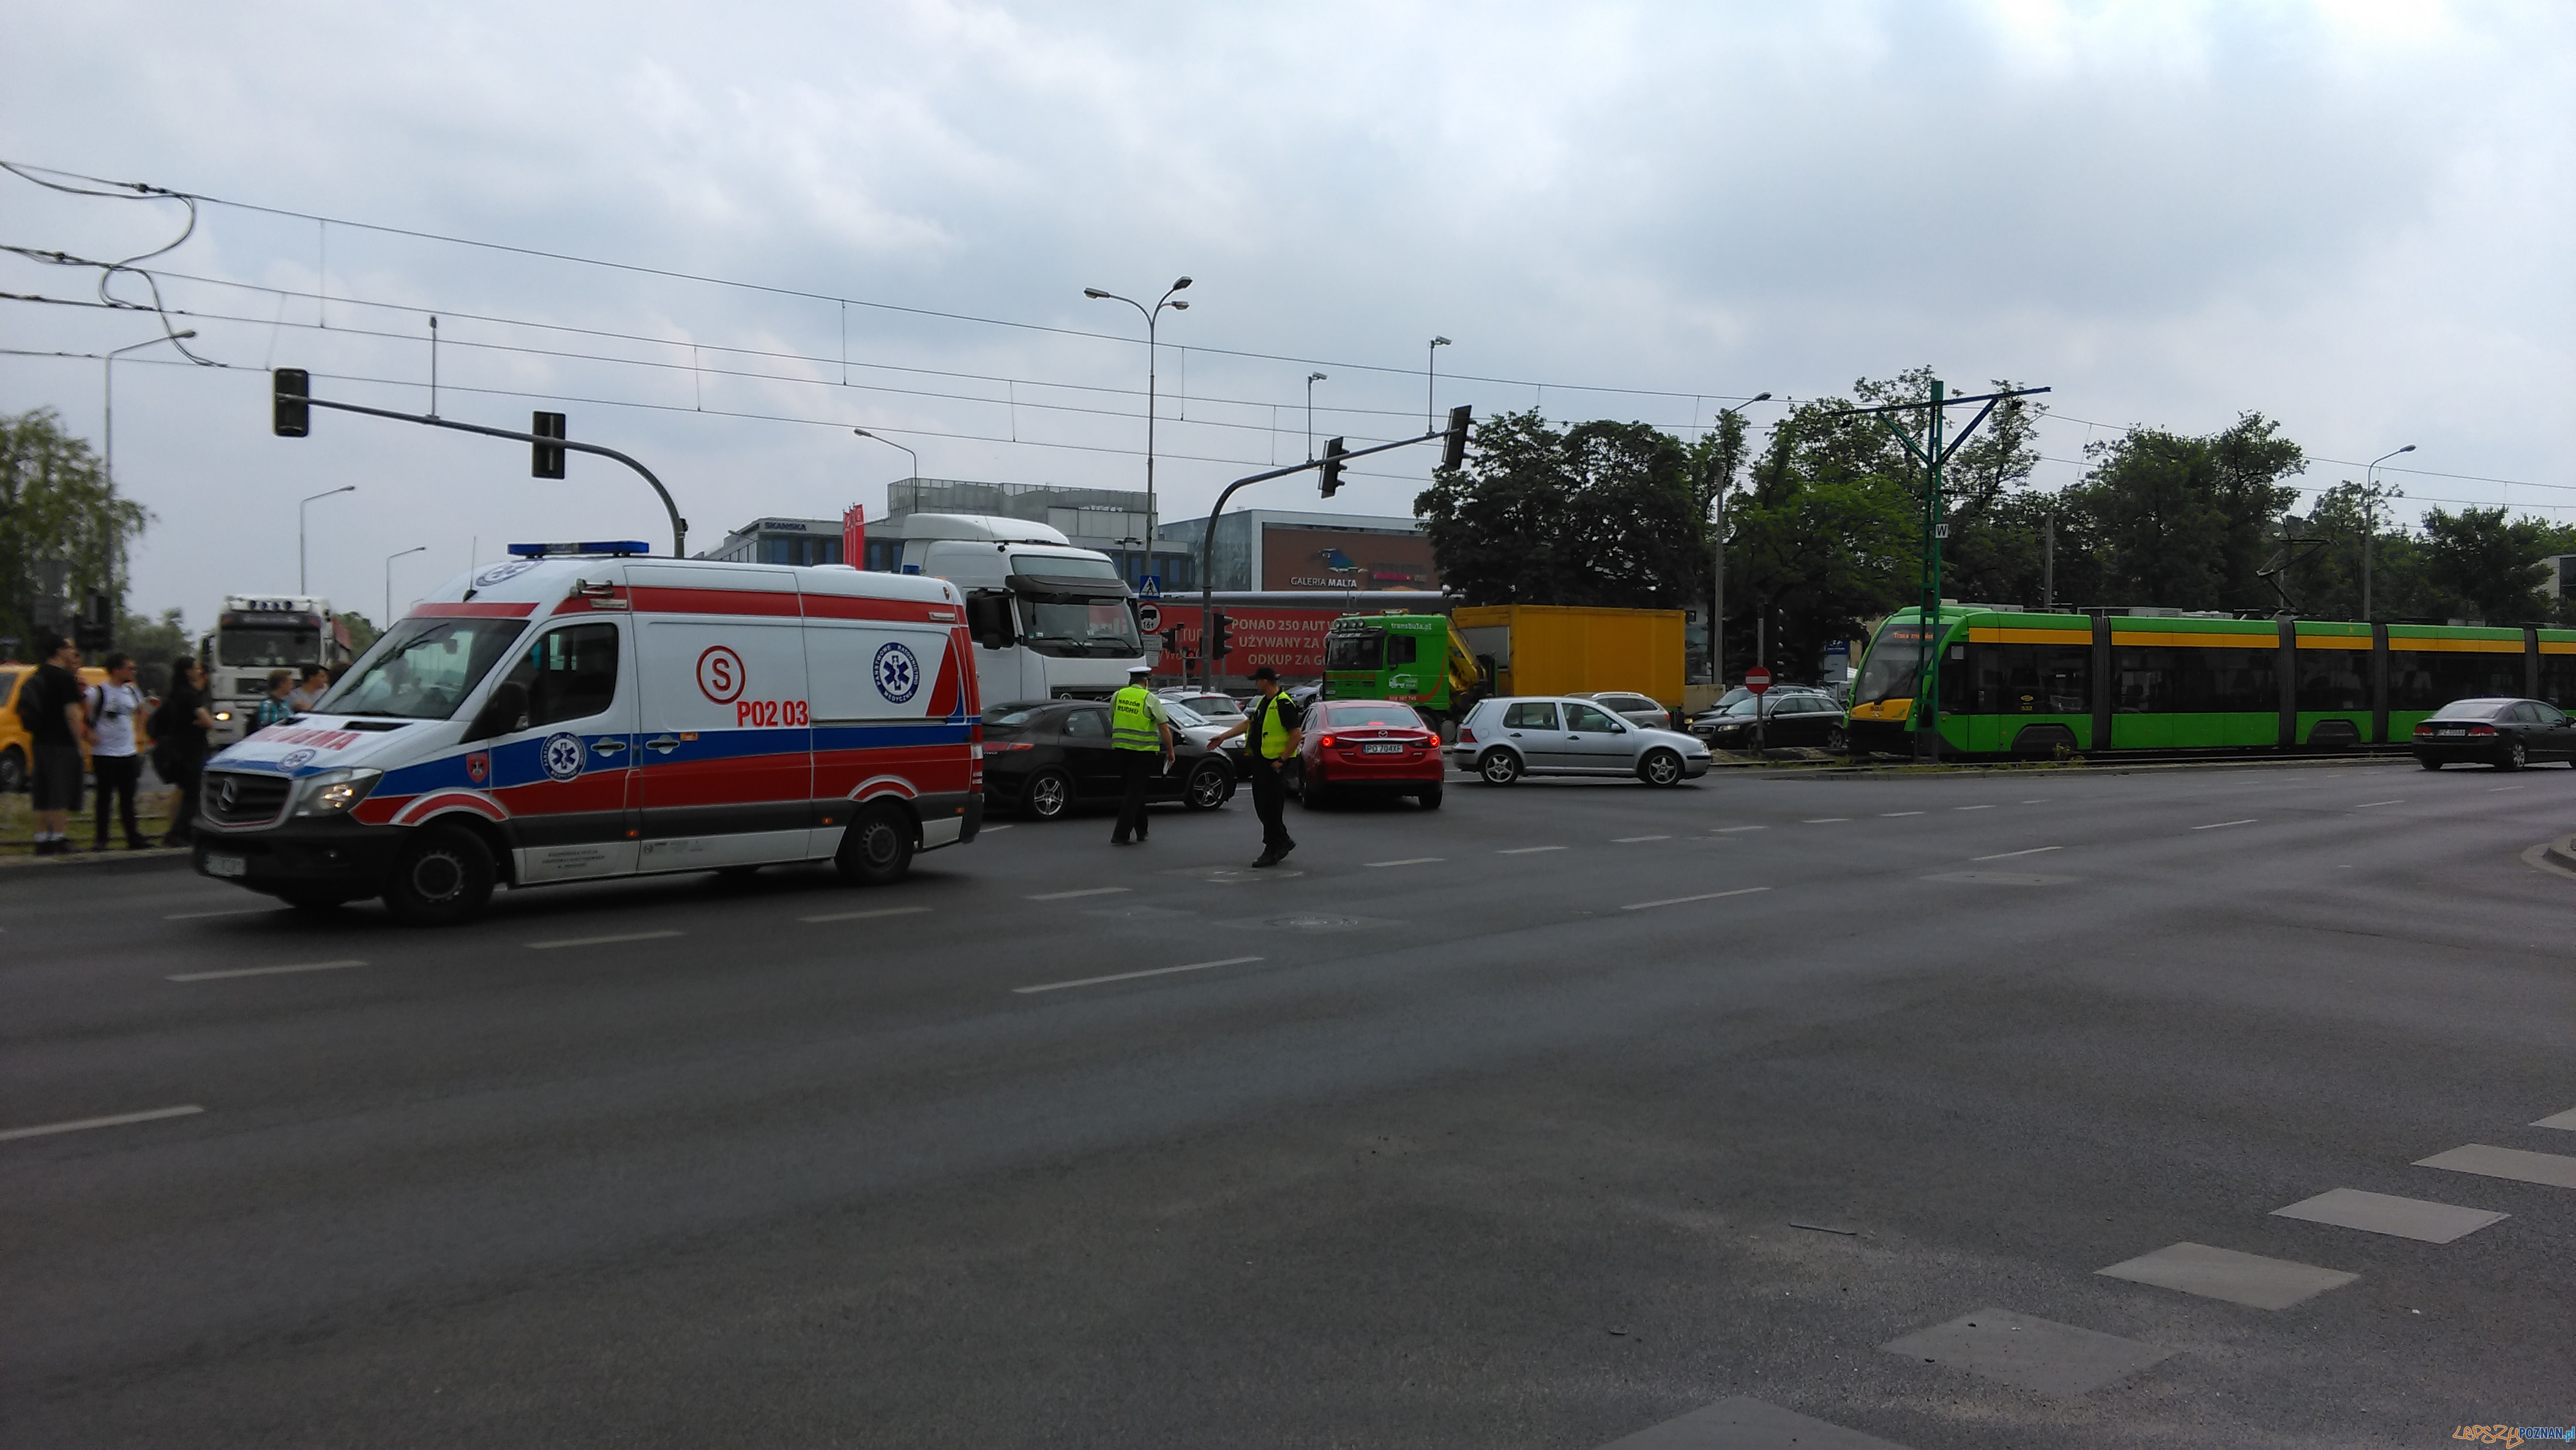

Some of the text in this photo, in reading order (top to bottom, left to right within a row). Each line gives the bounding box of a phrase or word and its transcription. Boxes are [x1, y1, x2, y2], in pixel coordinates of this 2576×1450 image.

[764, 522, 806, 532] SKANSKA
[1937, 525, 1947, 536] W
[1290, 577, 1357, 588] GALERIA MALTA
[1142, 620, 1154, 629] 16t
[1232, 619, 1275, 630] PONAD
[1278, 620, 1299, 631] 250
[1301, 620, 1325, 631] AUT
[1239, 634, 1301, 648] UŻYWANY
[1304, 638, 1320, 648] ZA
[897, 645, 919, 685] RATOWNICTWO
[1248, 654, 1292, 665] ODKUP
[1295, 655, 1311, 666] ZA
[711, 657, 732, 693] S
[883, 691, 913, 702] MEDYCZNE
[1118, 699, 1140, 708] NADZÓR
[782, 700, 809, 727] 03
[1117, 705, 1139, 715] RUCHU
